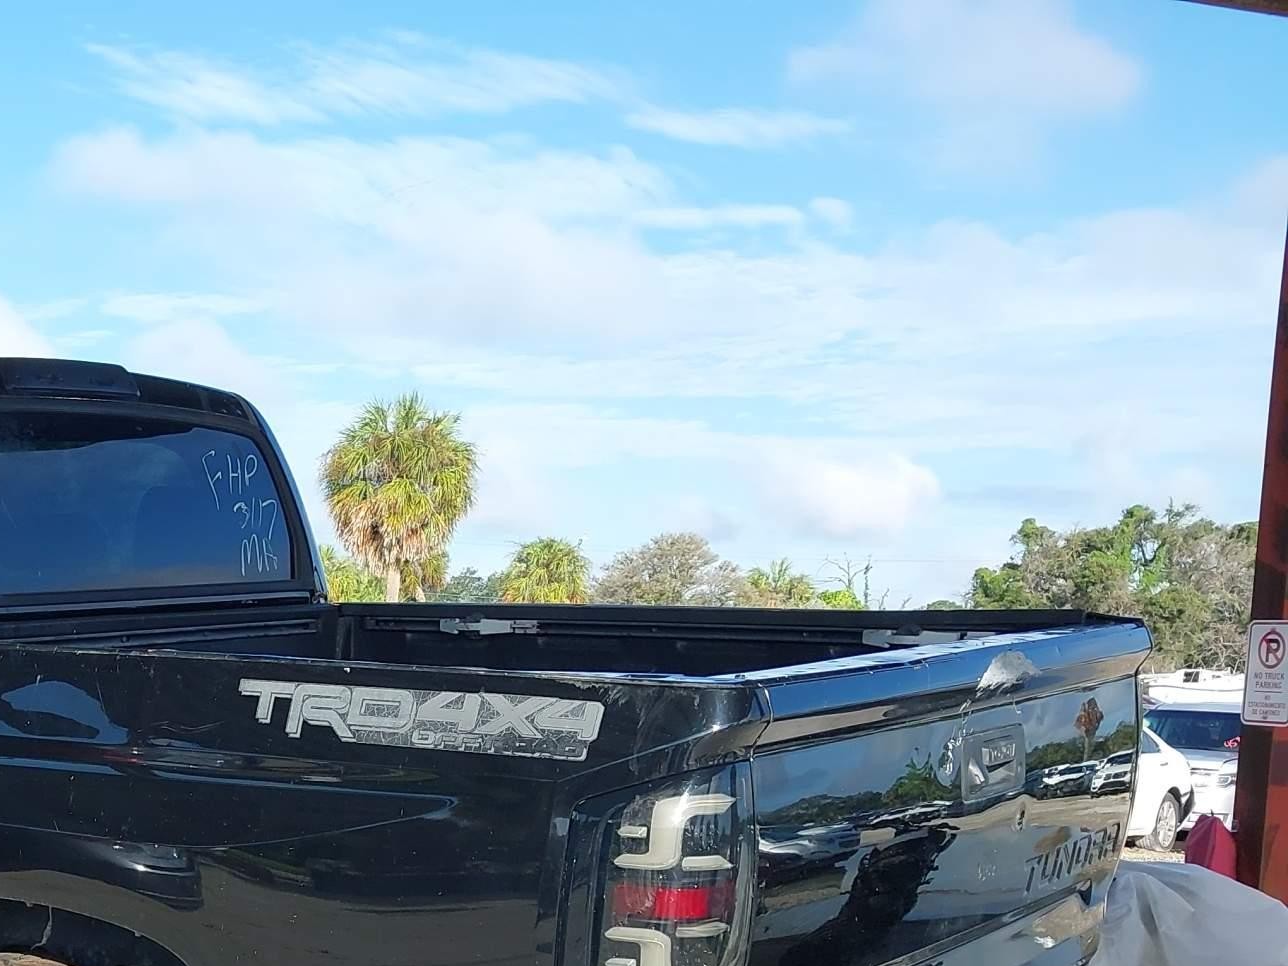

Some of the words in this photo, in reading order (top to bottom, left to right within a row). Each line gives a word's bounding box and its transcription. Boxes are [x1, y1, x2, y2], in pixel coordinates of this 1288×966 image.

[201, 449, 258, 511] FHP
[1253, 672, 1263, 680] NO
[1264, 672, 1285, 680] TRUCK
[1255, 681, 1282, 689] PARKING
[1024, 823, 1120, 893] TUNDRA
